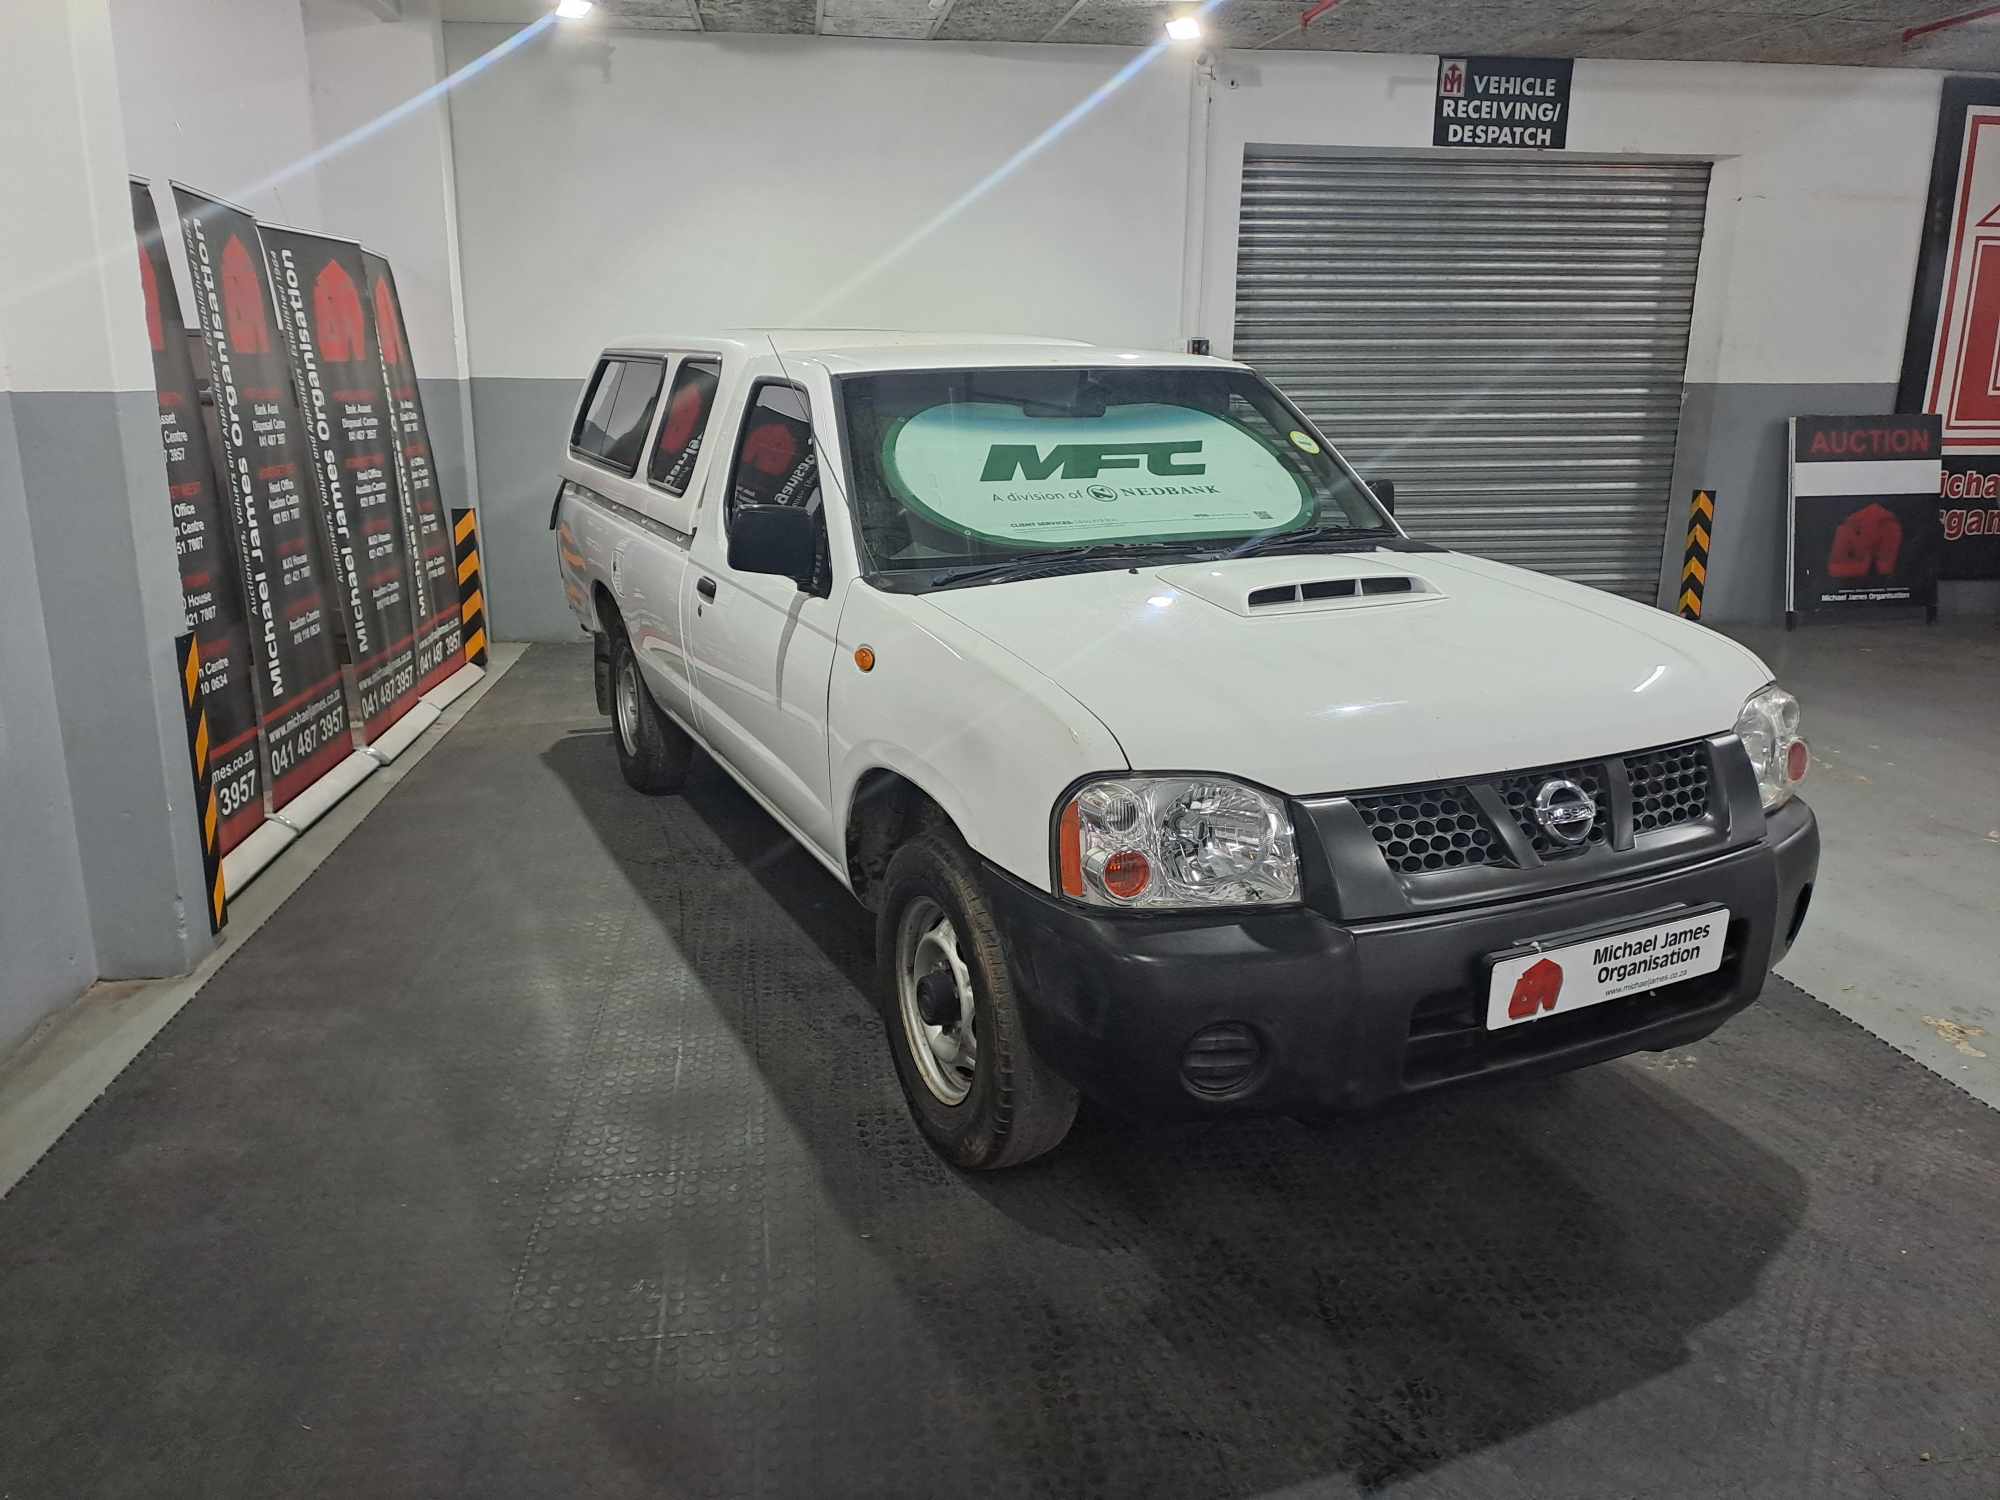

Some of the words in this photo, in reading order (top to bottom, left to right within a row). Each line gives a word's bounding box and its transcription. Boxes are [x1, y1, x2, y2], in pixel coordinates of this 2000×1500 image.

[1473, 75, 1556, 97] VEHICLE
[1442, 99, 1562, 122] RECEIVING/
[1447, 124, 1551, 146] DESPATCH
[193, 218, 243, 447] Organisation
[282, 249, 330, 441] Organisation
[980, 440, 1207, 482] MFC
[1810, 429, 1930, 453] AUCTION
[174, 503, 195, 517] Office
[238, 457, 264, 562] James
[324, 449, 350, 539] James
[992, 494, 1003, 503] A
[1007, 490, 1065, 503] division
[1068, 488, 1083, 500] of
[1121, 484, 1221, 498] NEDBANK
[181, 520, 205, 535] Centre
[187, 591, 212, 608] House
[341, 547, 368, 653] Michael
[255, 572, 283, 697] Michael
[205, 657, 229, 675] Centre
[361, 688, 380, 719] 041
[380, 679, 396, 704] 487
[395, 664, 414, 694] 3957
[272, 740, 295, 776] 041
[298, 724, 318, 757] 487
[320, 706, 344, 741] 3957
[220, 769, 256, 816] 3957
[1593, 933, 1659, 966] Michael
[1661, 924, 1711, 950] James
[1597, 945, 1702, 984] Organisation
